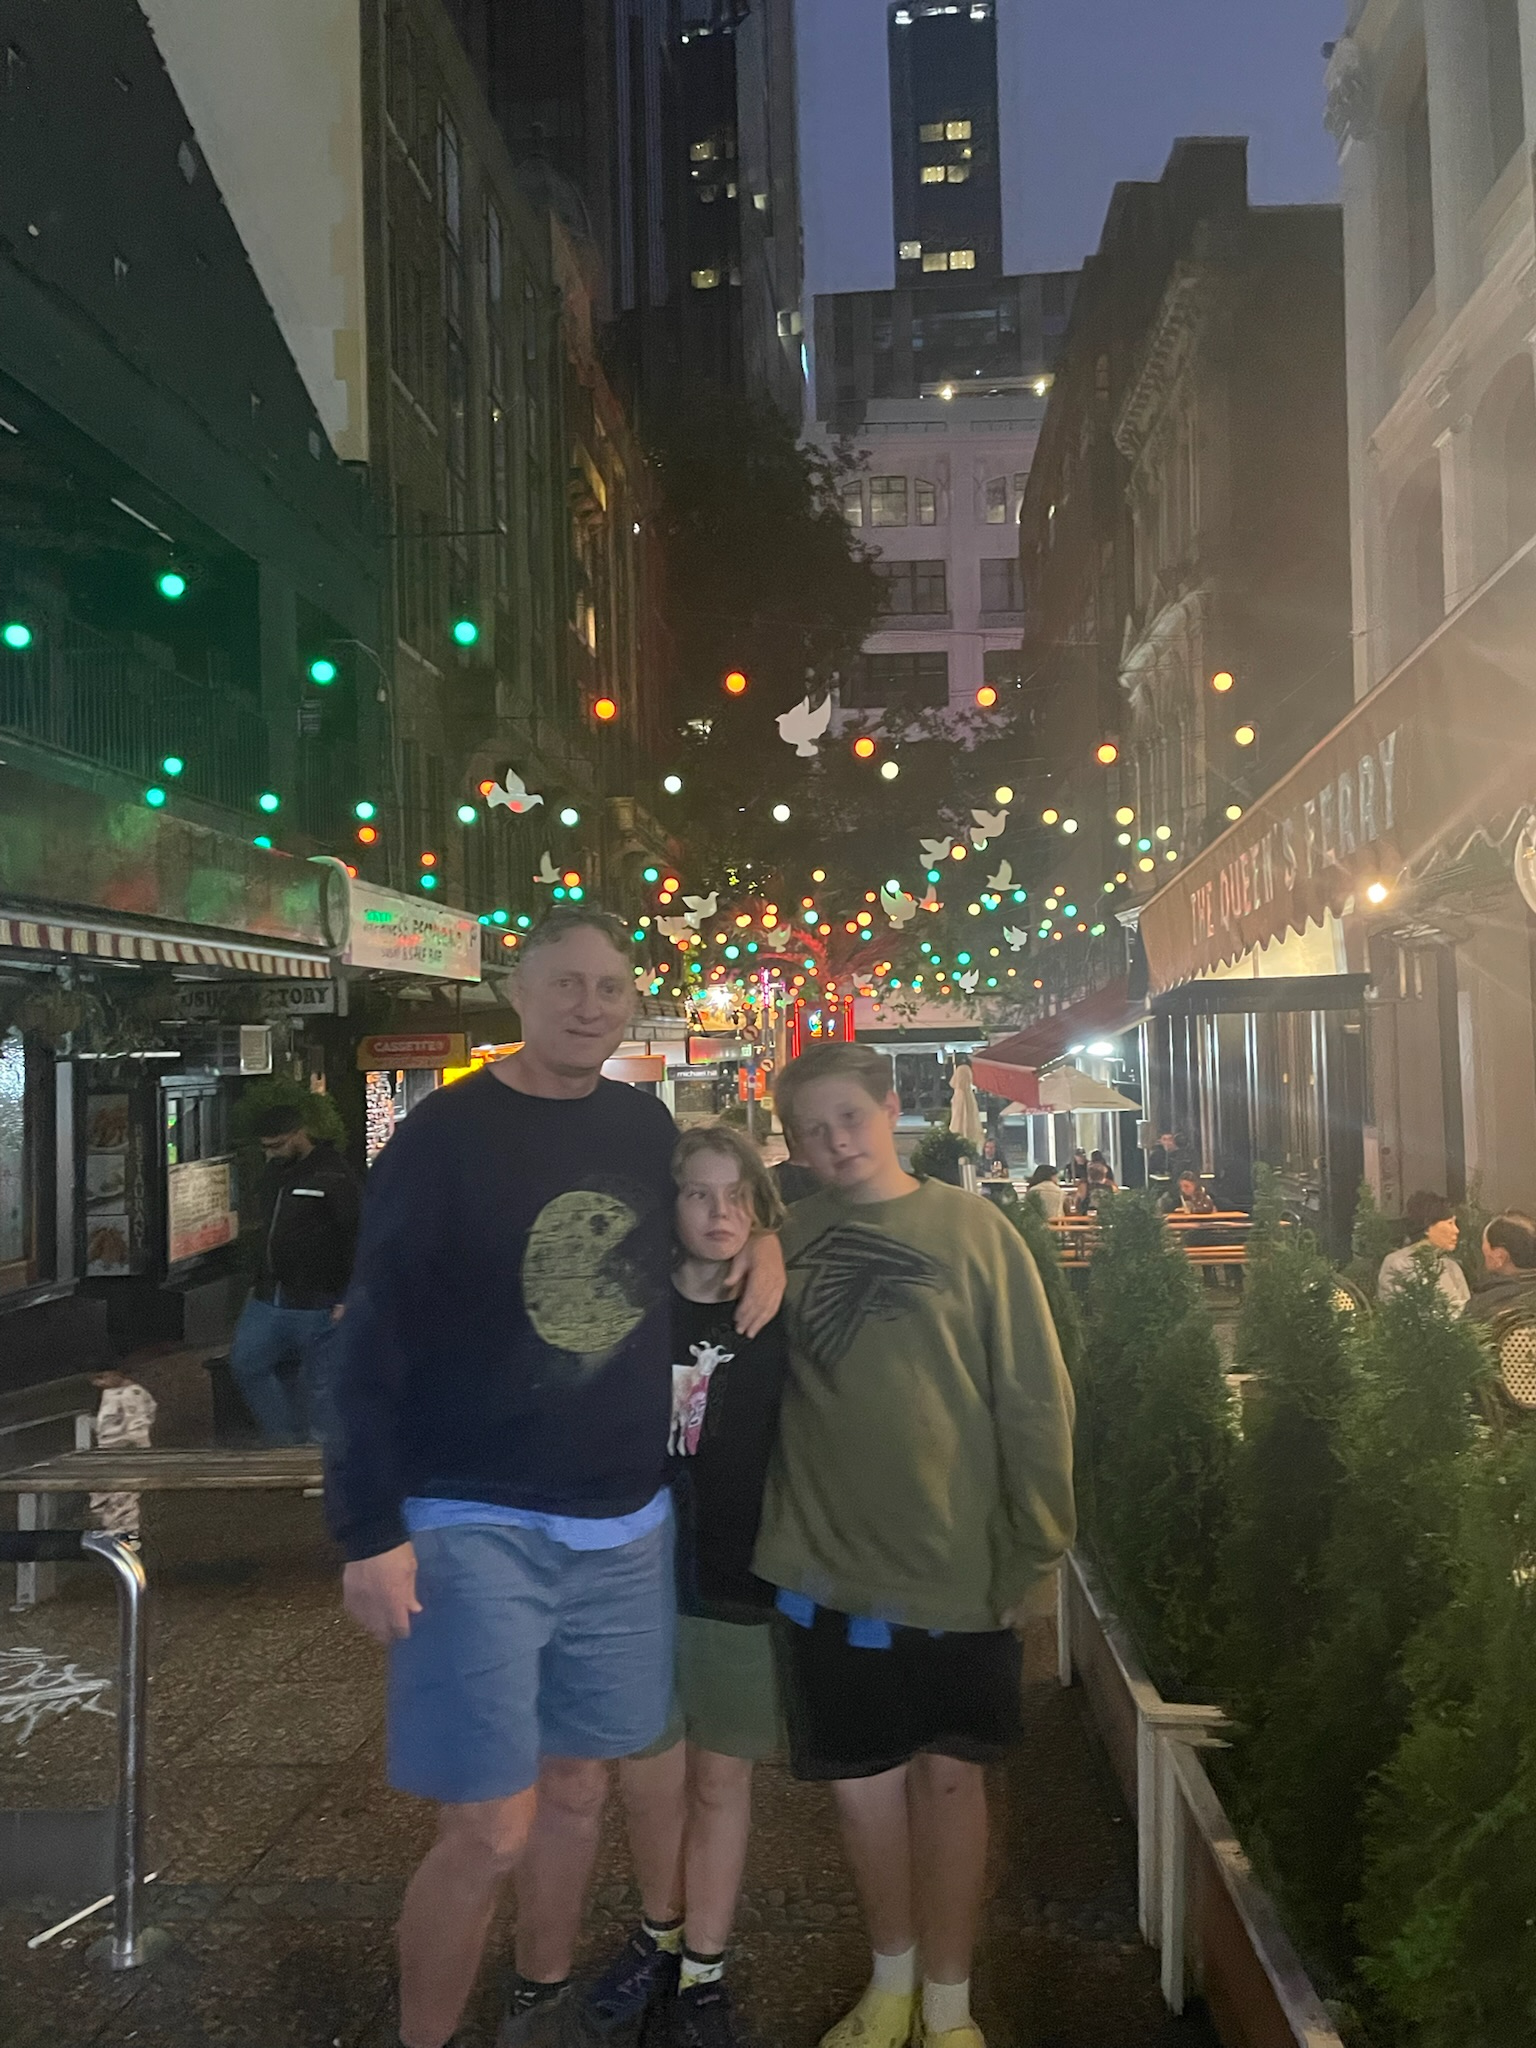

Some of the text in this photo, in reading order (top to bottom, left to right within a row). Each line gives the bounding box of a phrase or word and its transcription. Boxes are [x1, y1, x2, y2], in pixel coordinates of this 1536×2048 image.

[1191, 730, 1398, 946] THE QUEEN'S FERRY
[676, 1069, 718, 1077] michael hill
